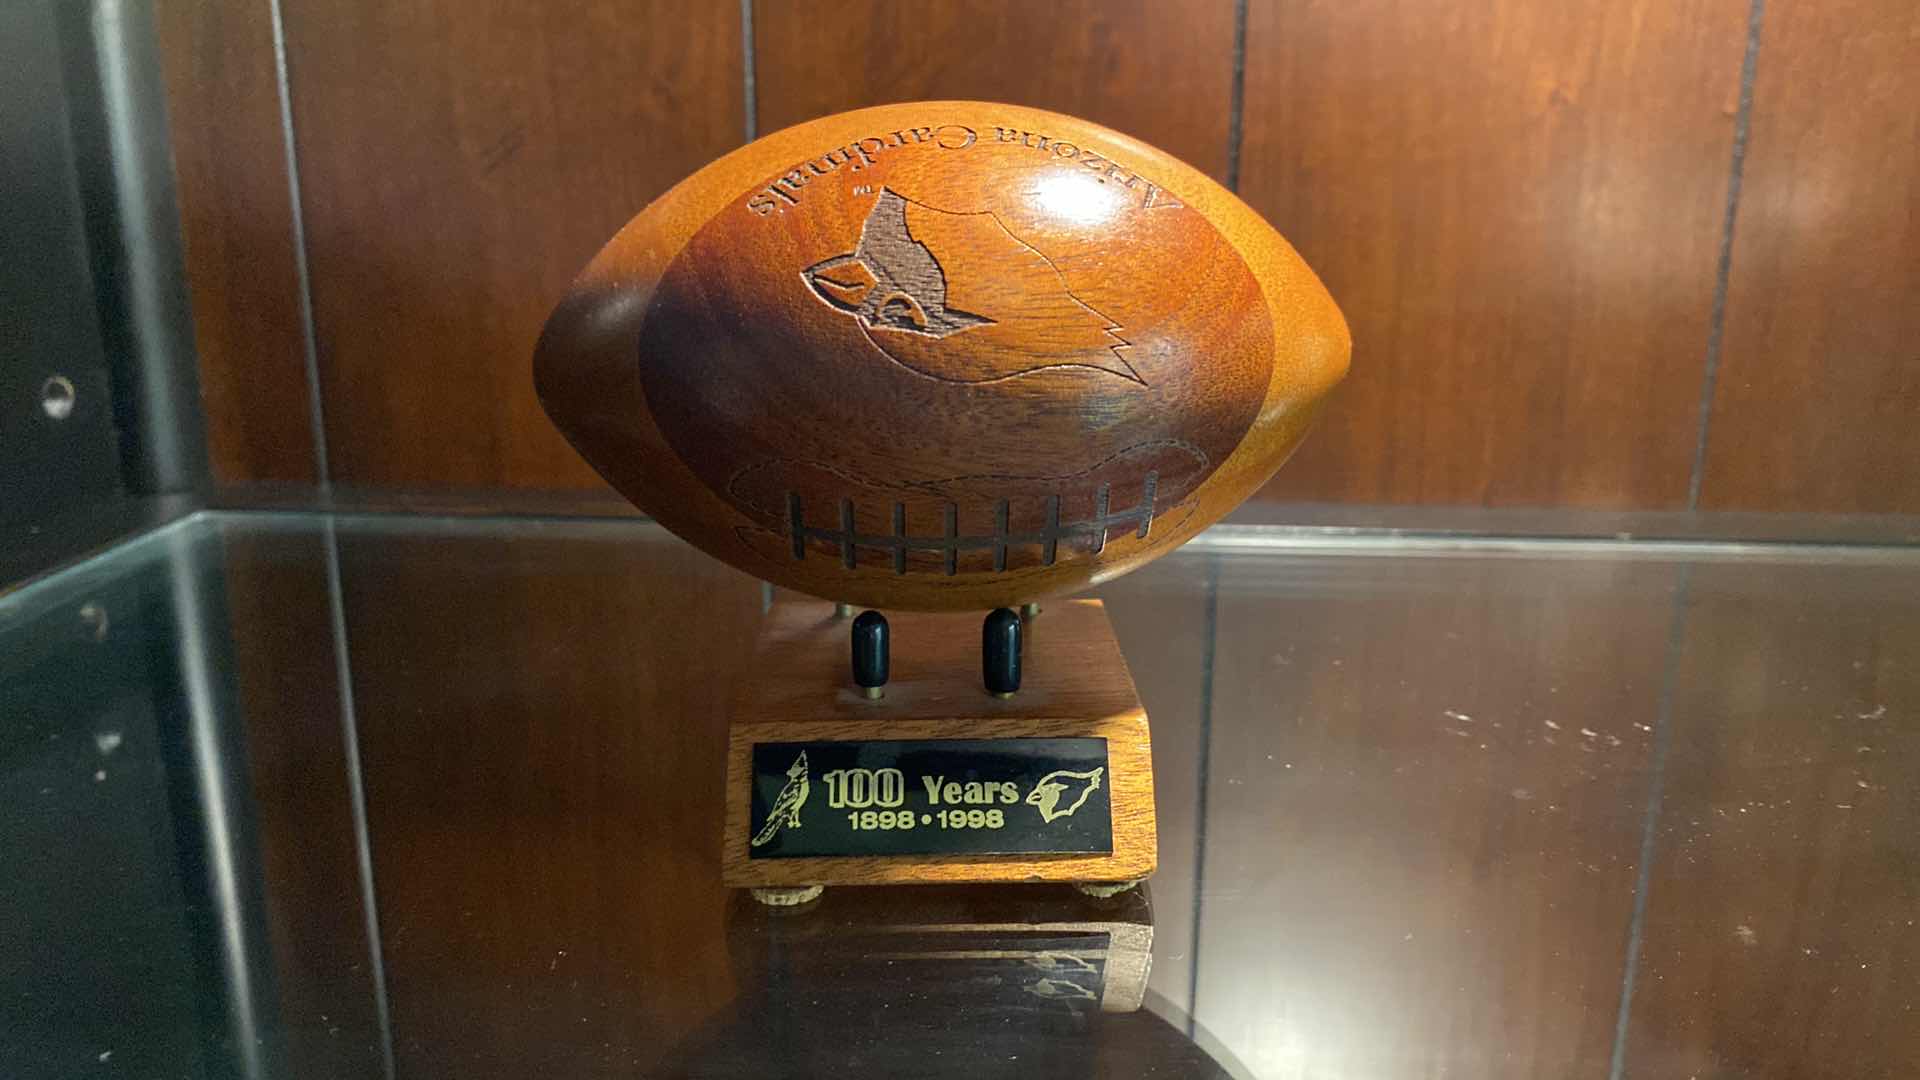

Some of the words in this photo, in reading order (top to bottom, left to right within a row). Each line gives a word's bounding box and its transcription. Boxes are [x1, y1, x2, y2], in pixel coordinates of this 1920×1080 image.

[747, 124, 977, 217] Cardinals
[993, 125, 1184, 210] Arizona
[824, 769, 904, 808] 100
[921, 775, 1020, 805] Years
